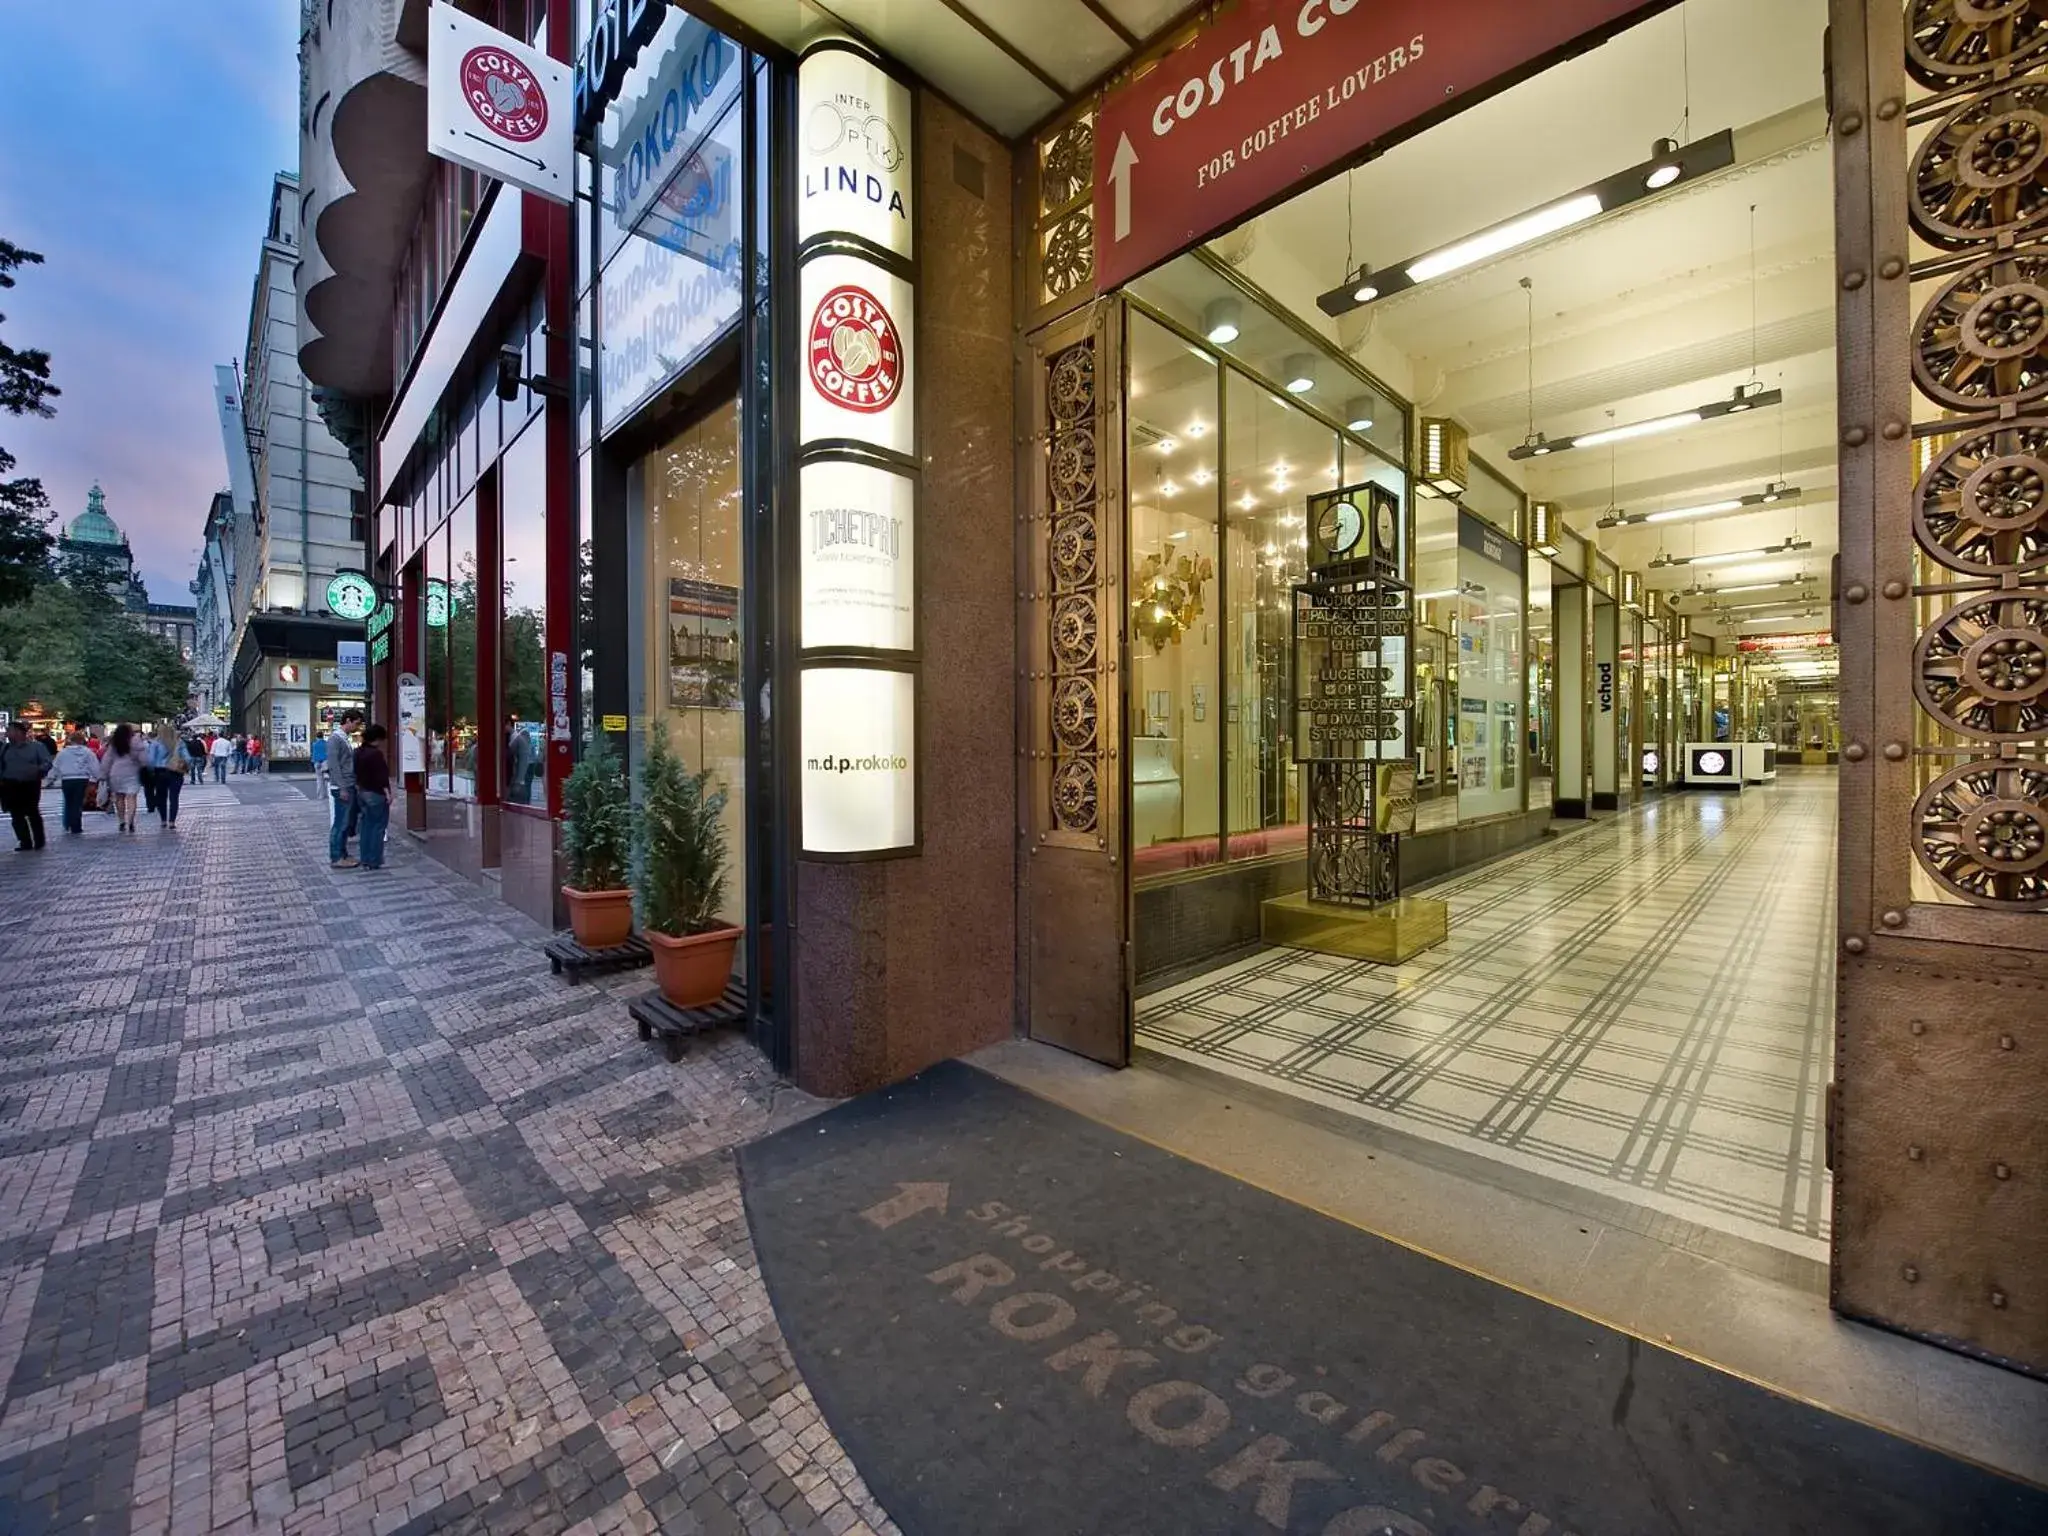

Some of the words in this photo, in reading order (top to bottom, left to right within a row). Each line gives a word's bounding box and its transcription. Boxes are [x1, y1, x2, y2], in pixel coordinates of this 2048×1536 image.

[477, 55, 531, 91] COSTA
[1152, 24, 1283, 136] COSTA
[472, 90, 538, 133] COFFEE
[614, 30, 722, 216] ROKOKO
[835, 93, 871, 112] INTER
[1198, 149, 1235, 189] FOR
[1241, 95, 1320, 160] COFFEE
[1327, 34, 1425, 111] LOVERS
[806, 166, 906, 219] LINDA
[820, 297, 886, 338] COSTA
[817, 358, 893, 402] COFFEE
[1320, 625, 1367, 636] TICKET
[1353, 610, 1407, 621] LUCRNA
[1345, 639, 1374, 650] HRY
[1311, 699, 1356, 710] COFFEE
[1597, 662, 1611, 712] vchod
[807, 754, 907, 774] m.d.p.rokoko
[966, 1199, 1225, 1354] Shopping
